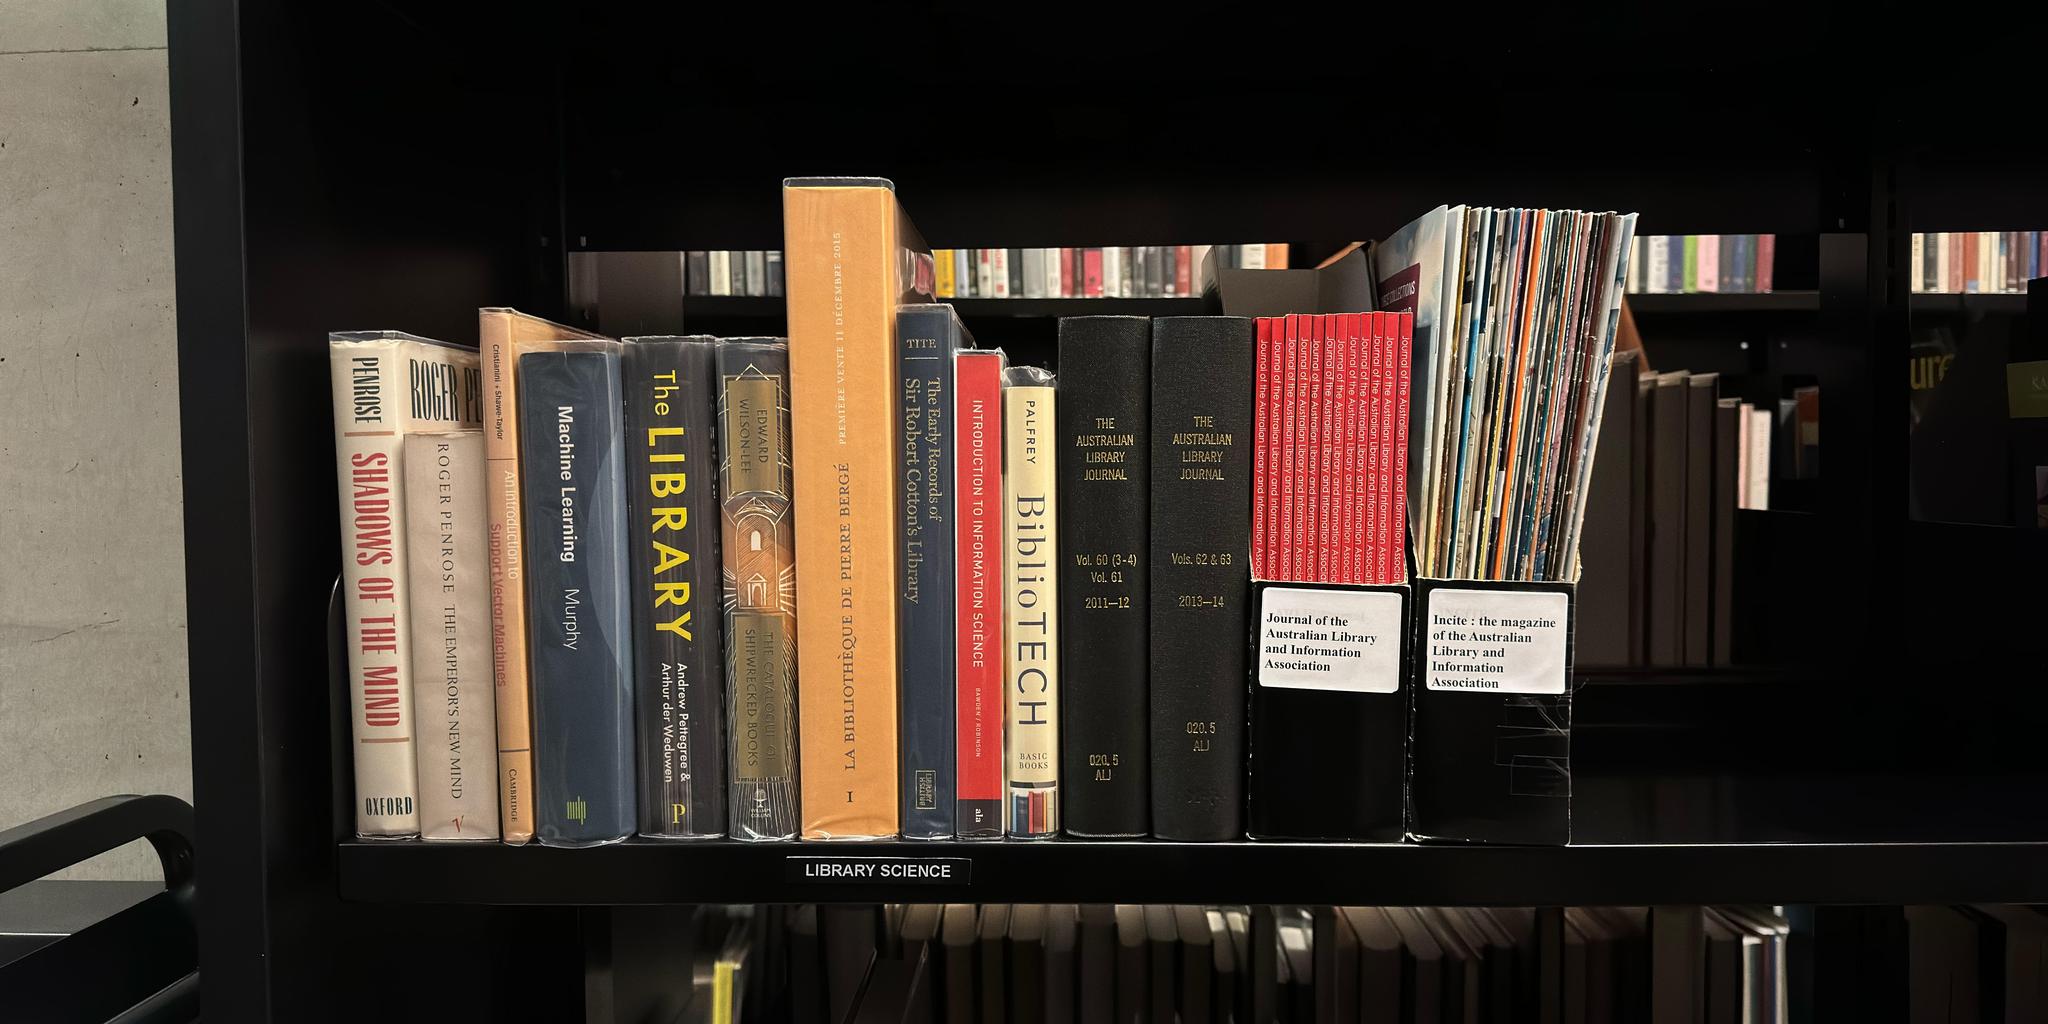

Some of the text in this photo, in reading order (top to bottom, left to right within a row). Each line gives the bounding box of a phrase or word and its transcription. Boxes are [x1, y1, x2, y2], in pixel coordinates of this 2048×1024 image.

[832, 232, 842, 259] 2015
[832, 263, 844, 326] DÉCEMBRE
[906, 338, 937, 349] TITE
[1260, 340, 1268, 372] Journal
[1274, 340, 1282, 373] Journal
[1401, 336, 1410, 370] Journal
[836, 346, 845, 386] VENTE
[352, 357, 382, 424] PENROSE
[410, 358, 460, 422] ROGER
[492, 344, 504, 440] Cristianini Shawe-Taylor
[906, 378, 921, 402] Sir
[1260, 384, 1268, 398] the
[834, 387, 846, 445] PREMIÈRE
[1096, 418, 1114, 429] THE
[1194, 416, 1214, 428] THE
[1258, 401, 1267, 443] Australian
[1272, 402, 1280, 444] Australian
[1398, 398, 1407, 440] Australian
[756, 409, 769, 464] EDWARD
[906, 406, 922, 466] Robert
[1026, 401, 1036, 464] PALFREY
[1076, 435, 1134, 446] AUSTRALIAN
[1172, 434, 1232, 446] AUSTRALIAN
[925, 377, 943, 522] The Early Records of
[1086, 452, 1126, 463] LIBRARY
[1182, 451, 1224, 462] LIBRARY
[1257, 445, 1266, 474] Library
[1270, 447, 1280, 475] Library
[1396, 442, 1406, 472] Library
[437, 444, 452, 504] ROGER
[1084, 469, 1128, 480] JOURNAL
[1180, 468, 1224, 480] JOURNAL
[648, 370, 692, 642] The LIBRARY
[1256, 494, 1264, 544] Information
[1395, 494, 1404, 544] Information
[558, 406, 580, 650] Machine Learning Murphy
[972, 400, 984, 668] INTRODUCTION TO INFORMATION SCIENCE
[1270, 498, 1278, 546] Information
[440, 511, 454, 592] PENROSE
[1076, 554, 1137, 568] Vol. 60 (3-4)
[1172, 552, 1232, 564] Vols. 62 & 63
[904, 539, 924, 604] Library
[1110, 572, 1122, 582] 61
[352, 452, 400, 726] SHADOWS OF THE MIND
[444, 604, 456, 634] THE
[490, 523, 506, 687] Support Vector Machines
[833, 463, 856, 770] LA BIBLIOTHÈQUE DE PIERRE BERGÉ
[1016, 493, 1048, 724] BiblioTECH
[1266, 613, 1312, 626] Journal
[1316, 616, 1328, 626] of
[1330, 616, 1348, 627] the
[1266, 628, 1378, 646] Australian Library
[1433, 630, 1532, 642] of the Australian
[1434, 615, 1468, 626] Incite
[1479, 616, 1498, 626] the
[1501, 618, 1556, 629] magazine
[1264, 659, 1331, 672] Association
[1266, 644, 1361, 658] and Information
[1433, 646, 1505, 660] Library and
[1432, 661, 1504, 673] Information
[1432, 677, 1499, 688] Association
[744, 628, 758, 767] SHIPWRECKED BOOKS
[448, 720, 460, 752] NEW
[661, 662, 674, 783] Arthur der Weduwen
[677, 662, 690, 782] Andrew Pettegree &
[450, 757, 462, 799] MIND
[1019, 762, 1048, 770] BOOKS
[1095, 770, 1112, 781] ALJ
[365, 797, 413, 816] OXFORD
[672, 804, 686, 824] P
[975, 808, 984, 823] ala
[806, 864, 951, 878] LIBRARY SCIENCE
